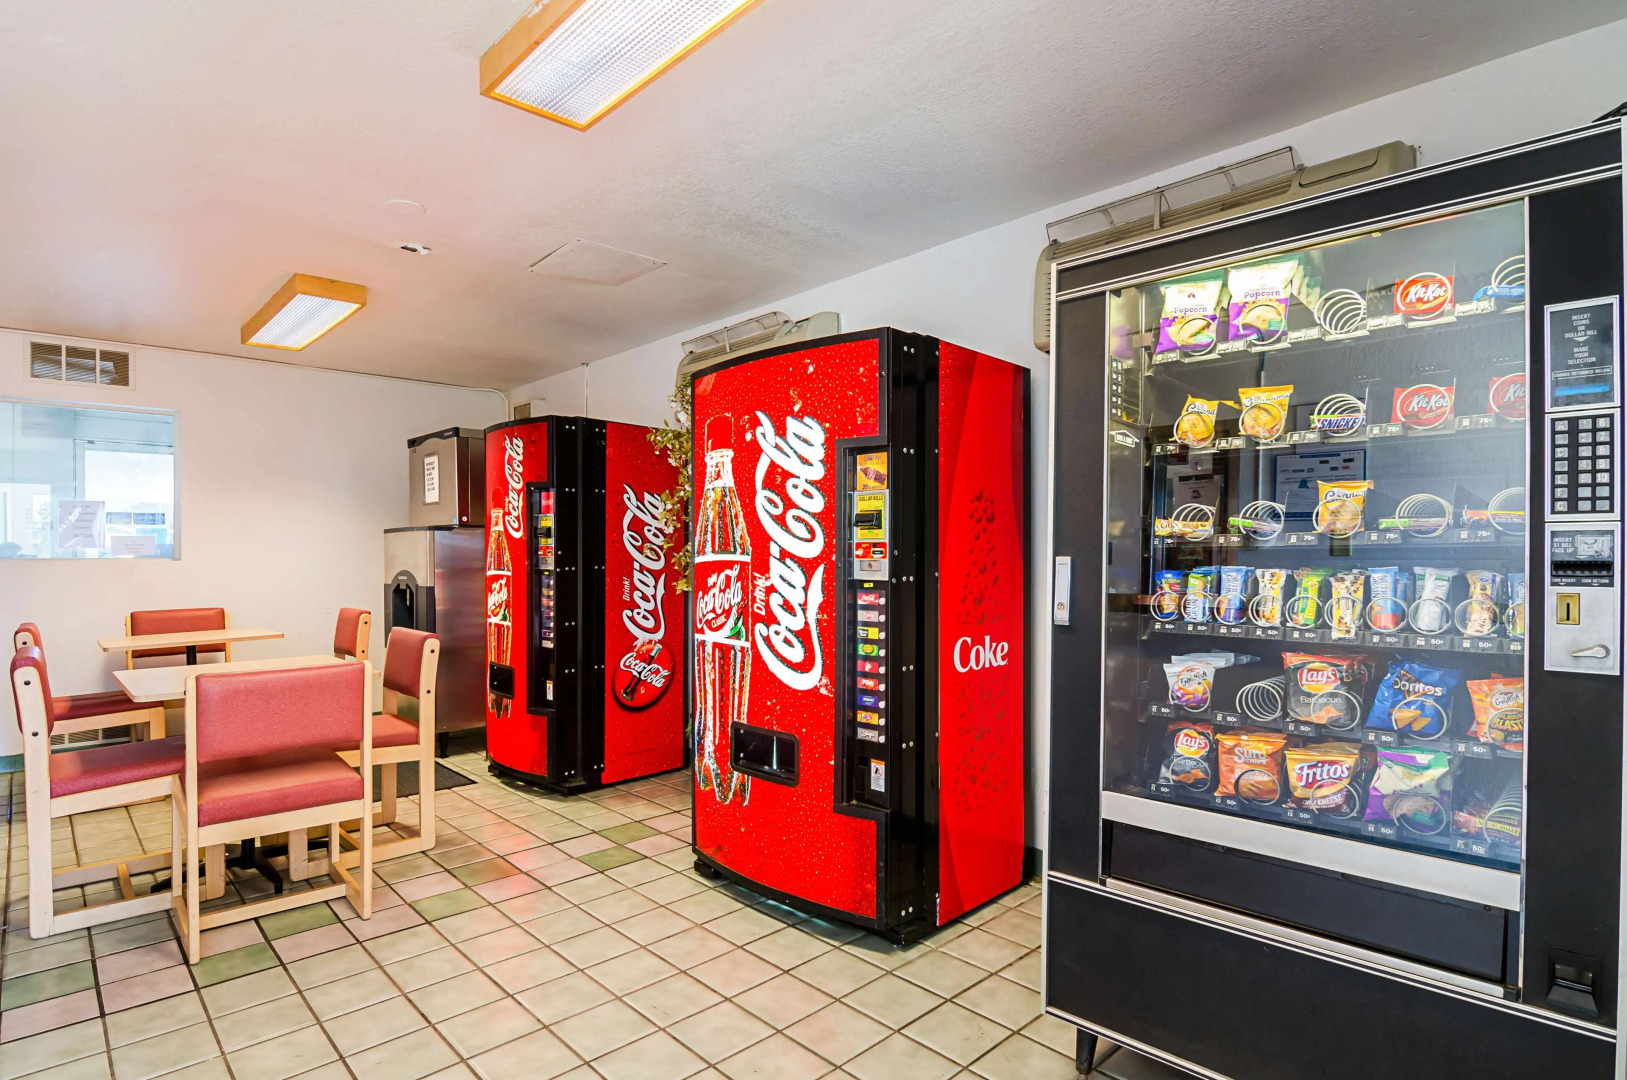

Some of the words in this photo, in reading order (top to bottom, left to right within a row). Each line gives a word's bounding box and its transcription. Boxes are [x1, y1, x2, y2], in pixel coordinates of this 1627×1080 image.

[1244, 289, 1281, 299] Popcorn
[1406, 282, 1447, 304] KitKat
[1174, 306, 1208, 315] Popcorn
[1564, 331, 1585, 339] DOLLAR
[1567, 357, 1597, 365] SELECTION
[504, 435, 524, 538] Coca-Cola
[622, 483, 667, 641] Coca-Cola
[755, 411, 826, 690] Coca-Cola
[622, 576, 631, 602] Drink!
[697, 563, 742, 629] Coca-Cola
[753, 572, 766, 616] Drink!
[953, 635, 1009, 673] Coke
[619, 652, 670, 689] Coca-Cola
[1300, 695, 1342, 704] Barbecue
[1393, 677, 1443, 697] Doritos
[1294, 761, 1350, 787] Fritos
[1318, 793, 1344, 806] CHEESE
